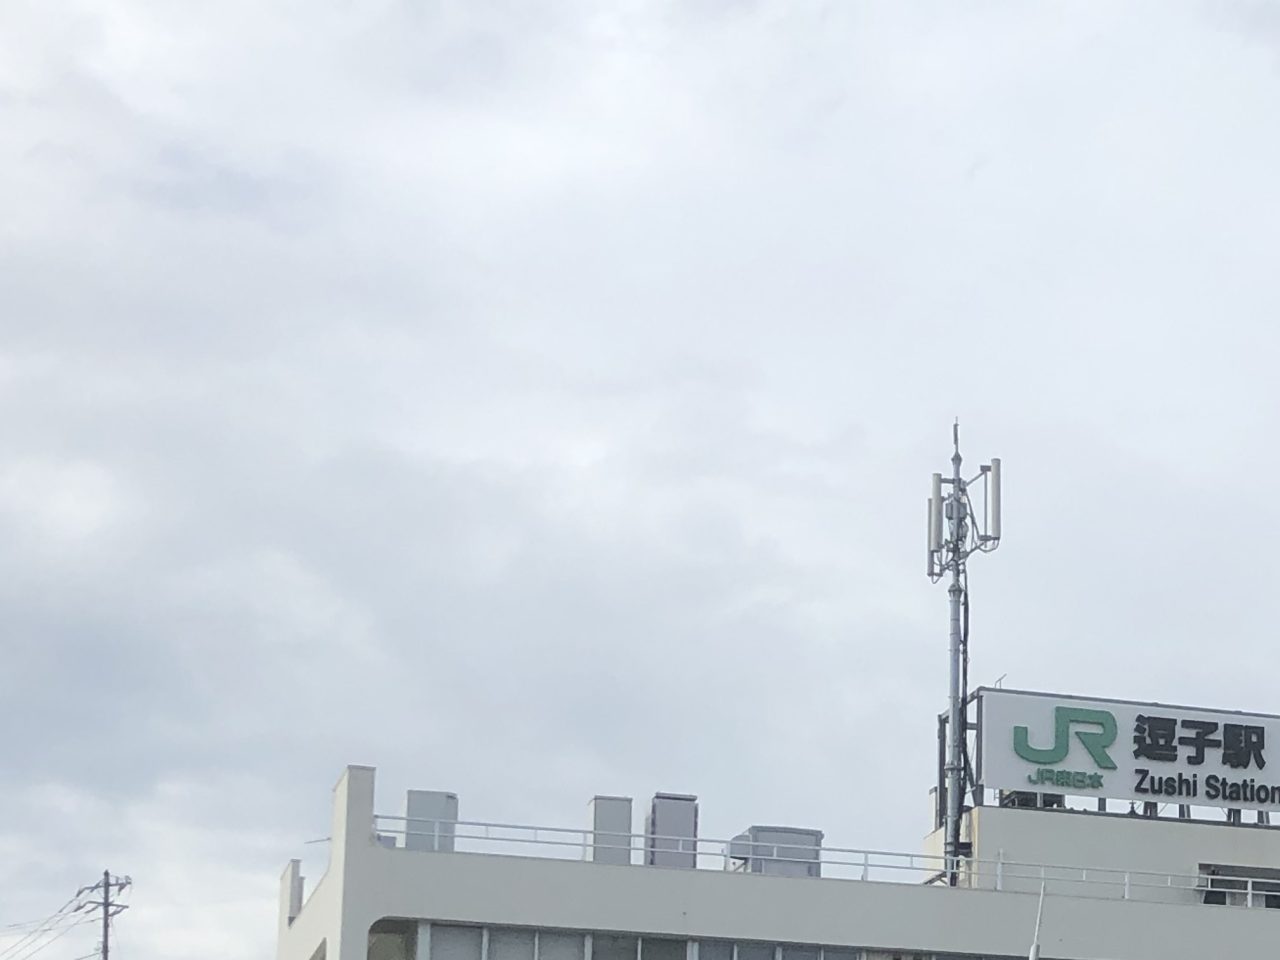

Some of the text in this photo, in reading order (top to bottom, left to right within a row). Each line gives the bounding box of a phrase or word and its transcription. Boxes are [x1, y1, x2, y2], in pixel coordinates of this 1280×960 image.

[1013, 706, 1118, 770] JR
[1133, 714, 1266, 771] 逗子駅
[1027, 767, 1104, 789] JR東日本
[1134, 769, 1197, 797] Zushi
